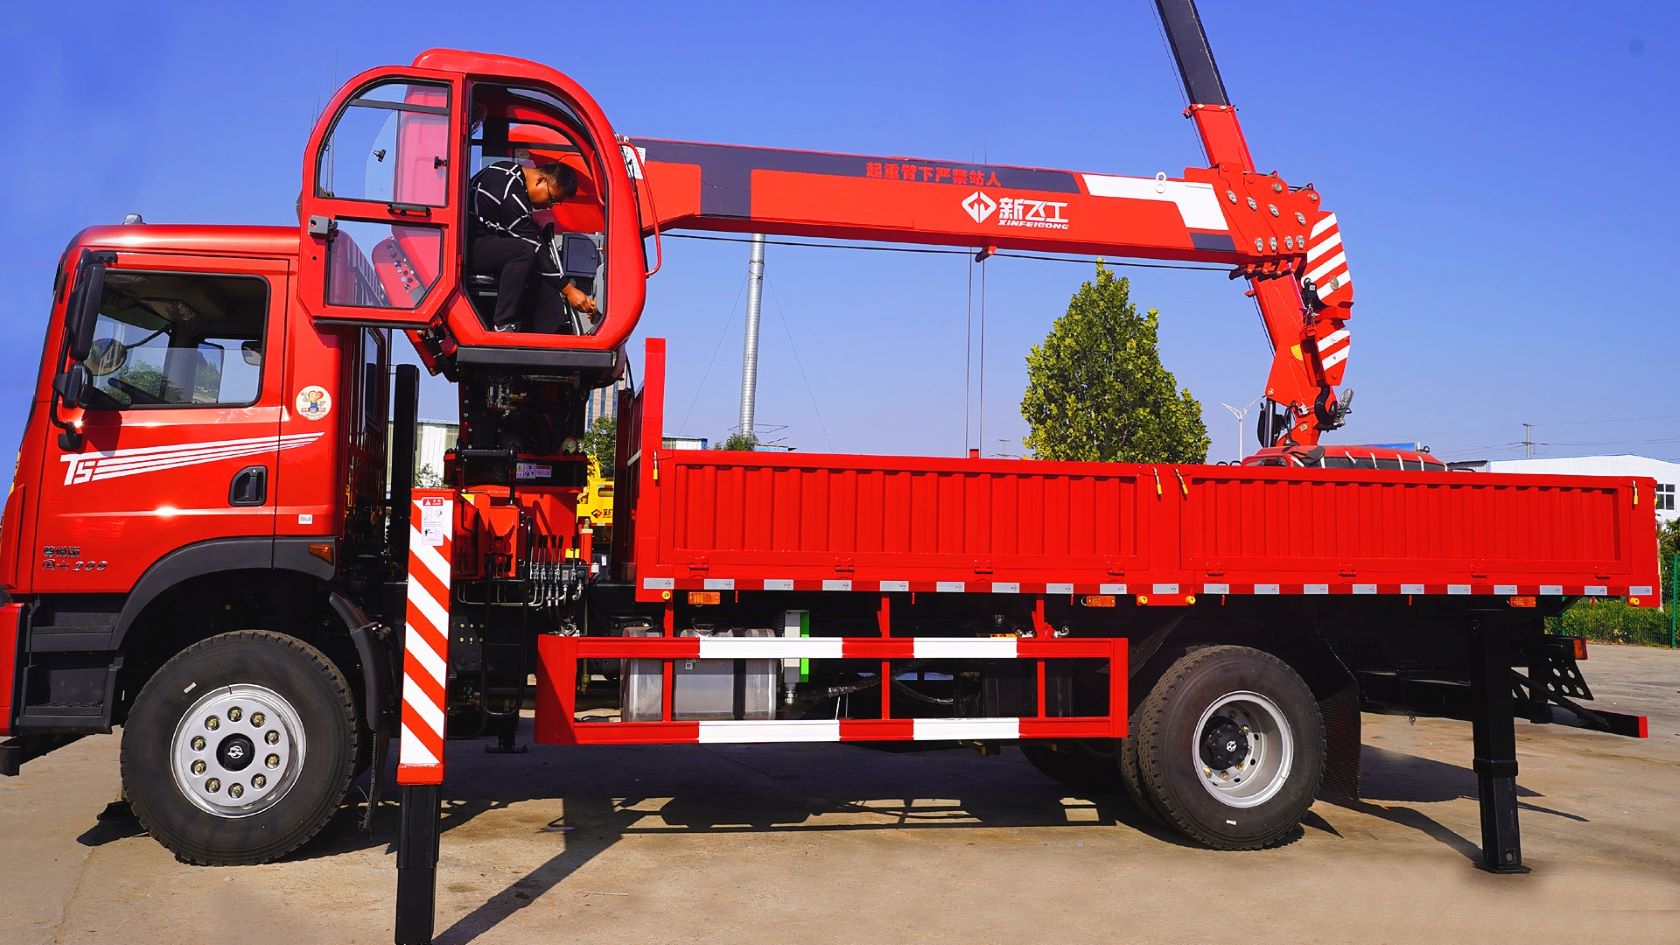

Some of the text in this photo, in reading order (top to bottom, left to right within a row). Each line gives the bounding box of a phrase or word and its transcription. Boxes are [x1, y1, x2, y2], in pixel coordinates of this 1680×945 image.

[866, 161, 1001, 187] 起重臂下严禁站人
[998, 197, 1069, 223] 新飞工
[998, 220, 1069, 230] XINFEIGONG
